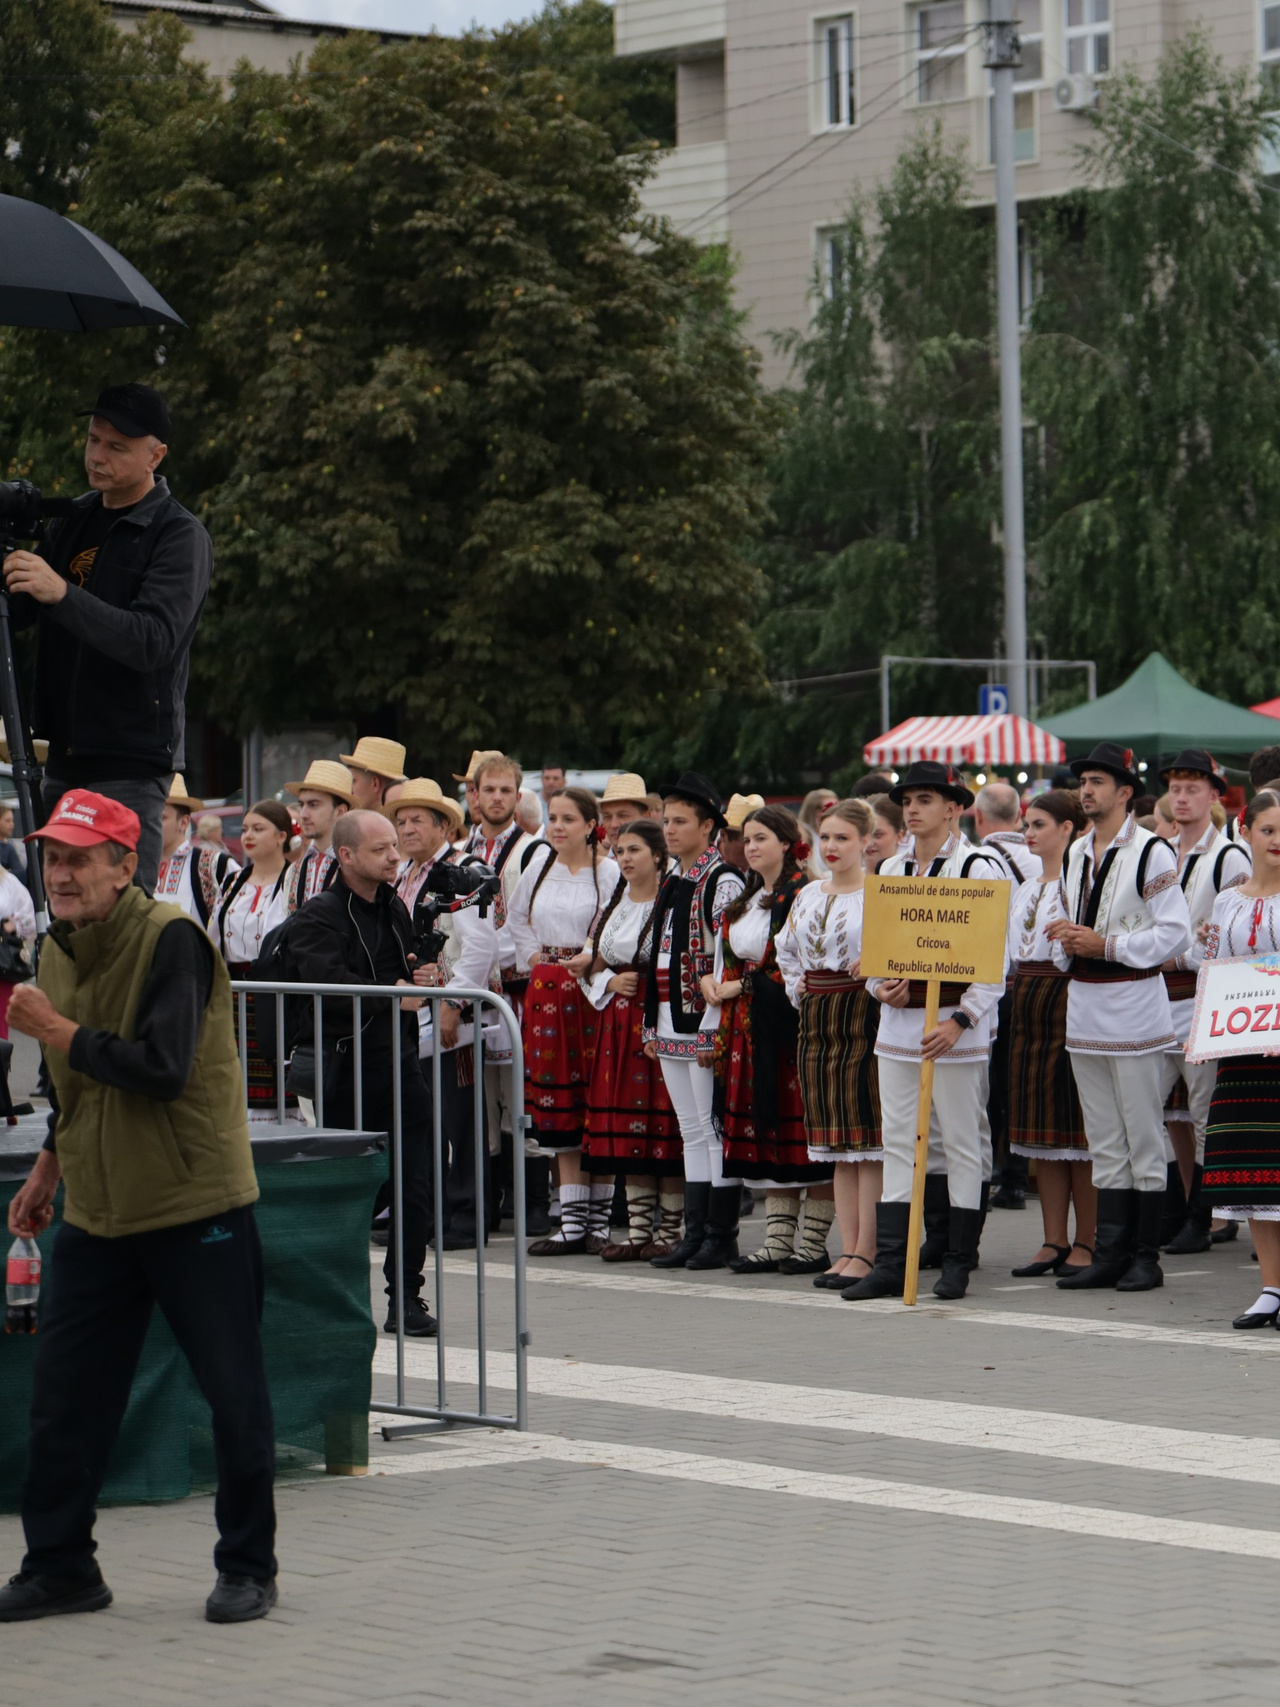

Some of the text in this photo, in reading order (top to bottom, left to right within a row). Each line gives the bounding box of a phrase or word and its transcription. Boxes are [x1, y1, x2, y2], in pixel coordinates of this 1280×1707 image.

[879, 883, 995, 900] Ansamblul de dans popular
[460, 892, 481, 908] RONIN
[900, 907, 970, 924] HORA MARE
[916, 936, 950, 949] Cricova
[887, 959, 975, 976] Republica Moldova
[1224, 989, 1276, 1001] ANSAMBLUL
